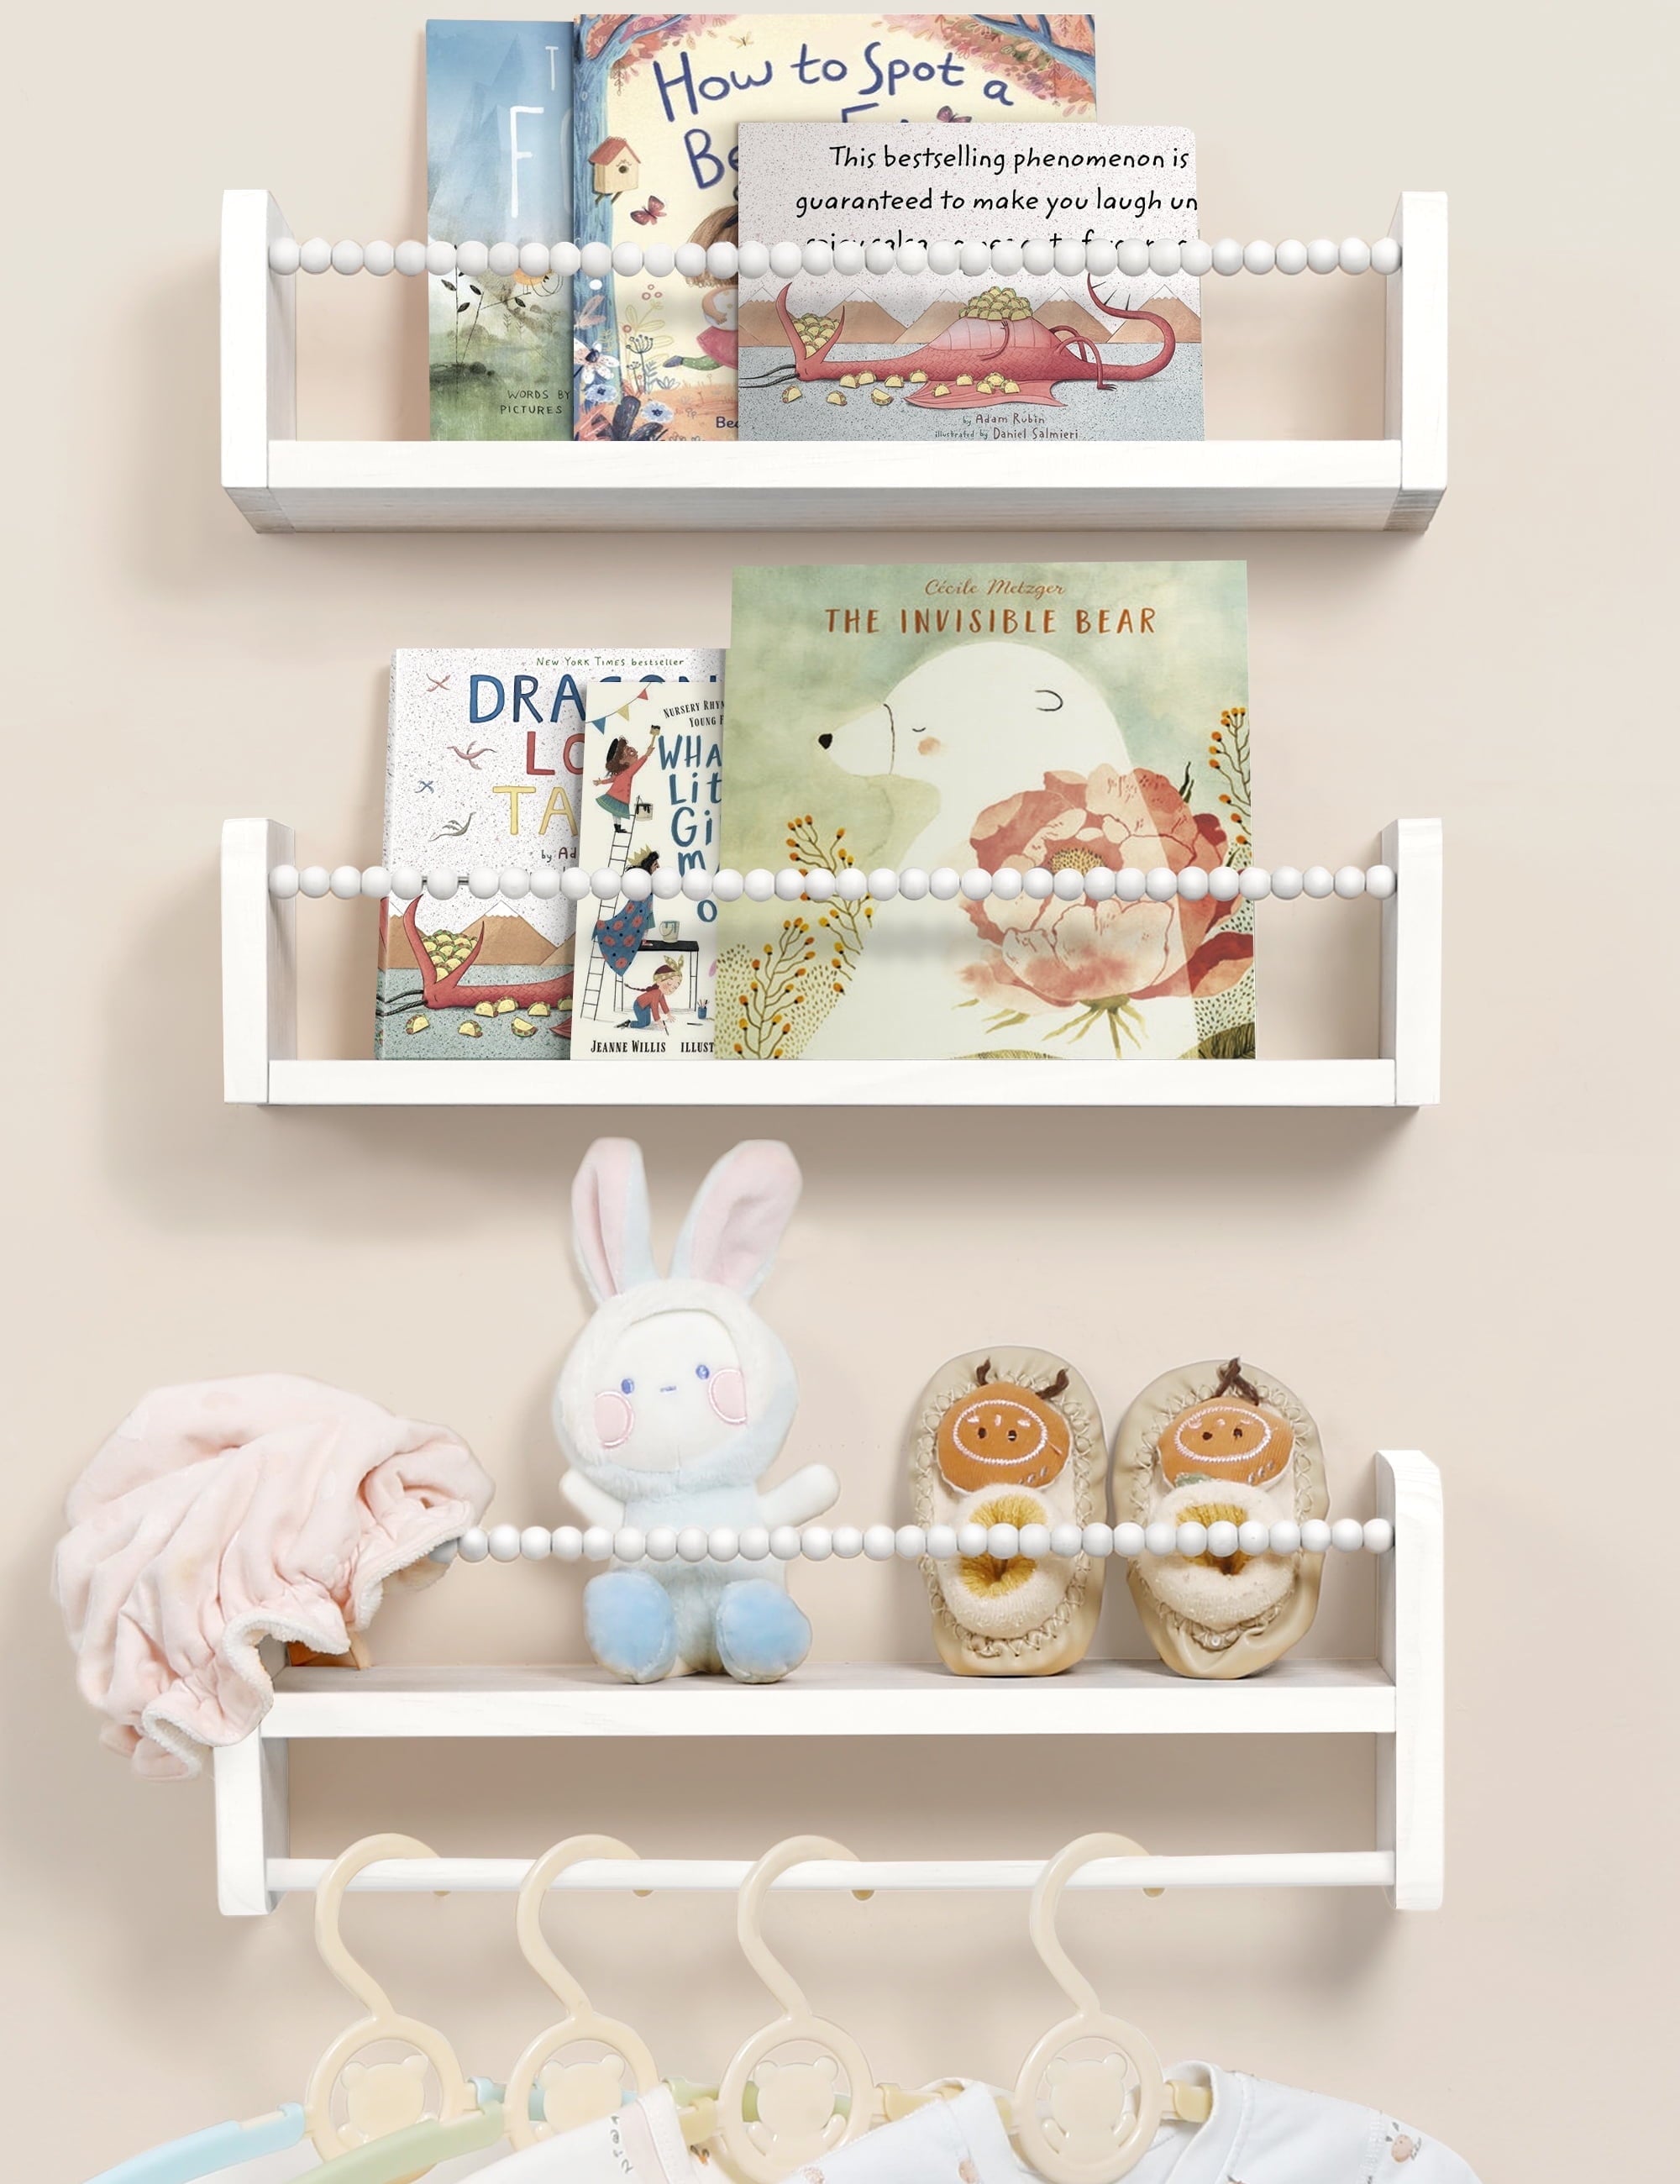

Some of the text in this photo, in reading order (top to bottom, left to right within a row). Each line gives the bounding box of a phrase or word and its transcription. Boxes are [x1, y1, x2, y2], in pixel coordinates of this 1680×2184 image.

[653, 41, 1014, 122] How to Spot a
[510, 106, 572, 218] F
[829, 144, 1189, 175] This bestselling phenomenon is
[795, 186, 1198, 219] guaranteed to make you laugh un
[507, 390, 571, 400] WORDS BY
[501, 405, 562, 414] PICTURES
[963, 412, 1045, 425] by Adam Rubin
[979, 430, 988, 439] by
[993, 428, 1026, 439] Daniel
[1032, 428, 1079, 439] Salmieri
[925, 580, 1066, 600] Cécile Metzger
[825, 607, 1156, 634] THE INVISIBLE BEAR
[537, 657, 685, 666] NEW YORK TIMES bestseller
[663, 702, 700, 719] NURSERY
[689, 716, 716, 727] YOUNG
[659, 734, 722, 770] WHA
[492, 786, 579, 836] TA
[541, 847, 576, 863] by Ad
[591, 1040, 714, 1053] JEANNE WILLIS ILLUST
